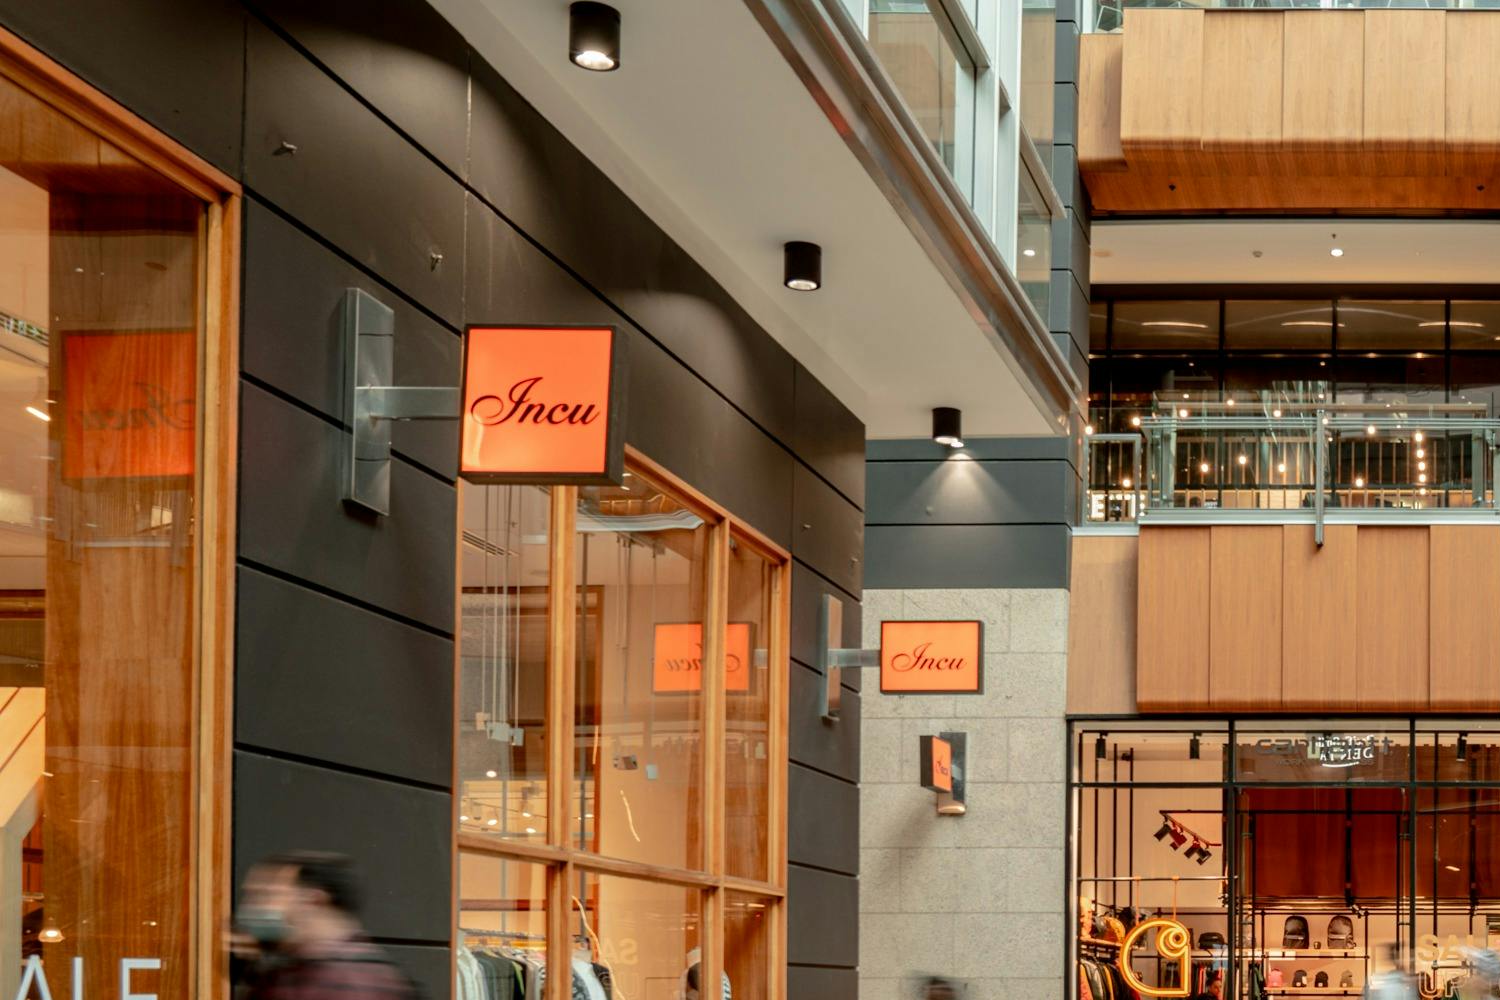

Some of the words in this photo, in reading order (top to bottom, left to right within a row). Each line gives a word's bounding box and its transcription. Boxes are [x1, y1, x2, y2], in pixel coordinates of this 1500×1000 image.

[470, 377, 600, 427] Incu
[891, 642, 967, 672] Incu
[1256, 736, 1394, 756] cartt
